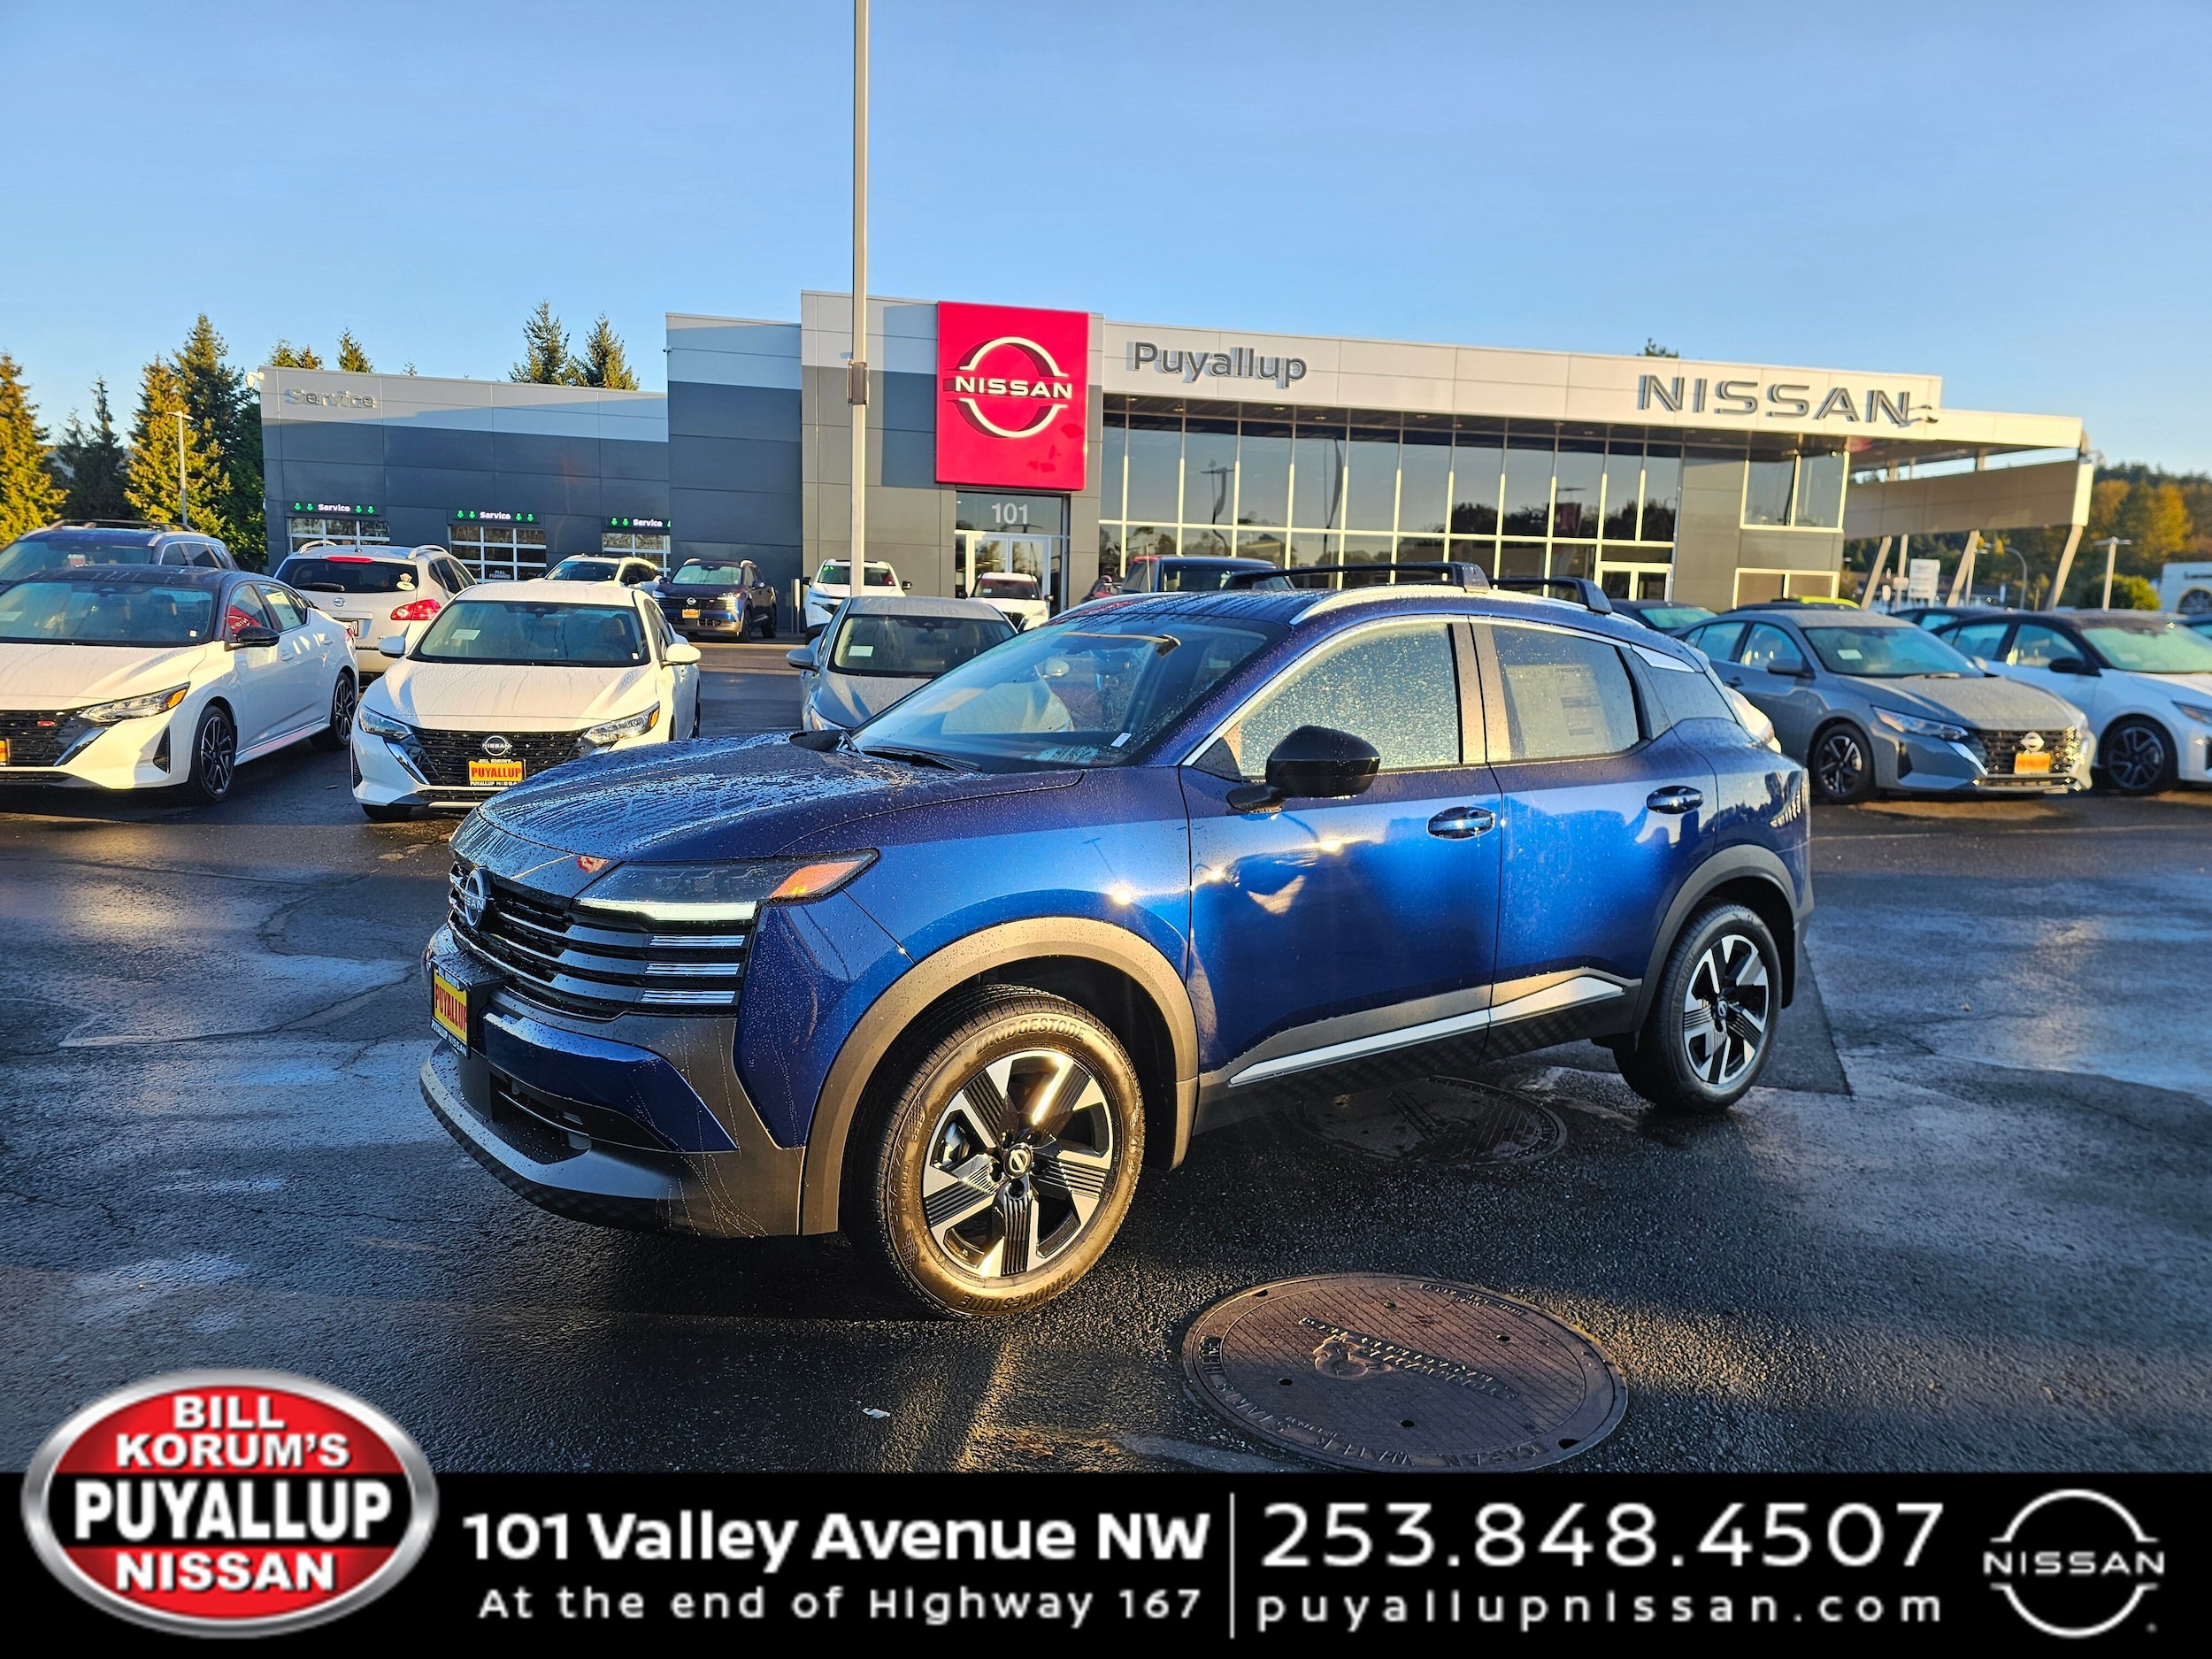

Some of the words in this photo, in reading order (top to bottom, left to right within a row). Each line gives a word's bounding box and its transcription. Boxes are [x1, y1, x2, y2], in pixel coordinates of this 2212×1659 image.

[1132, 342, 1307, 389] Puyallup
[285, 388, 375, 408] Service
[955, 375, 1072, 399] NISSAN
[1638, 374, 1911, 426] NISSAN
[318, 503, 351, 512] Service
[479, 511, 511, 520] Service
[991, 502, 1028, 525] 101
[633, 518, 663, 527] Service
[471, 767, 521, 778] PUYALLUP
[974, 1018, 1086, 1056] BRIDGESTONE
[959, 1268, 1073, 1312] BRIDGESTONE
